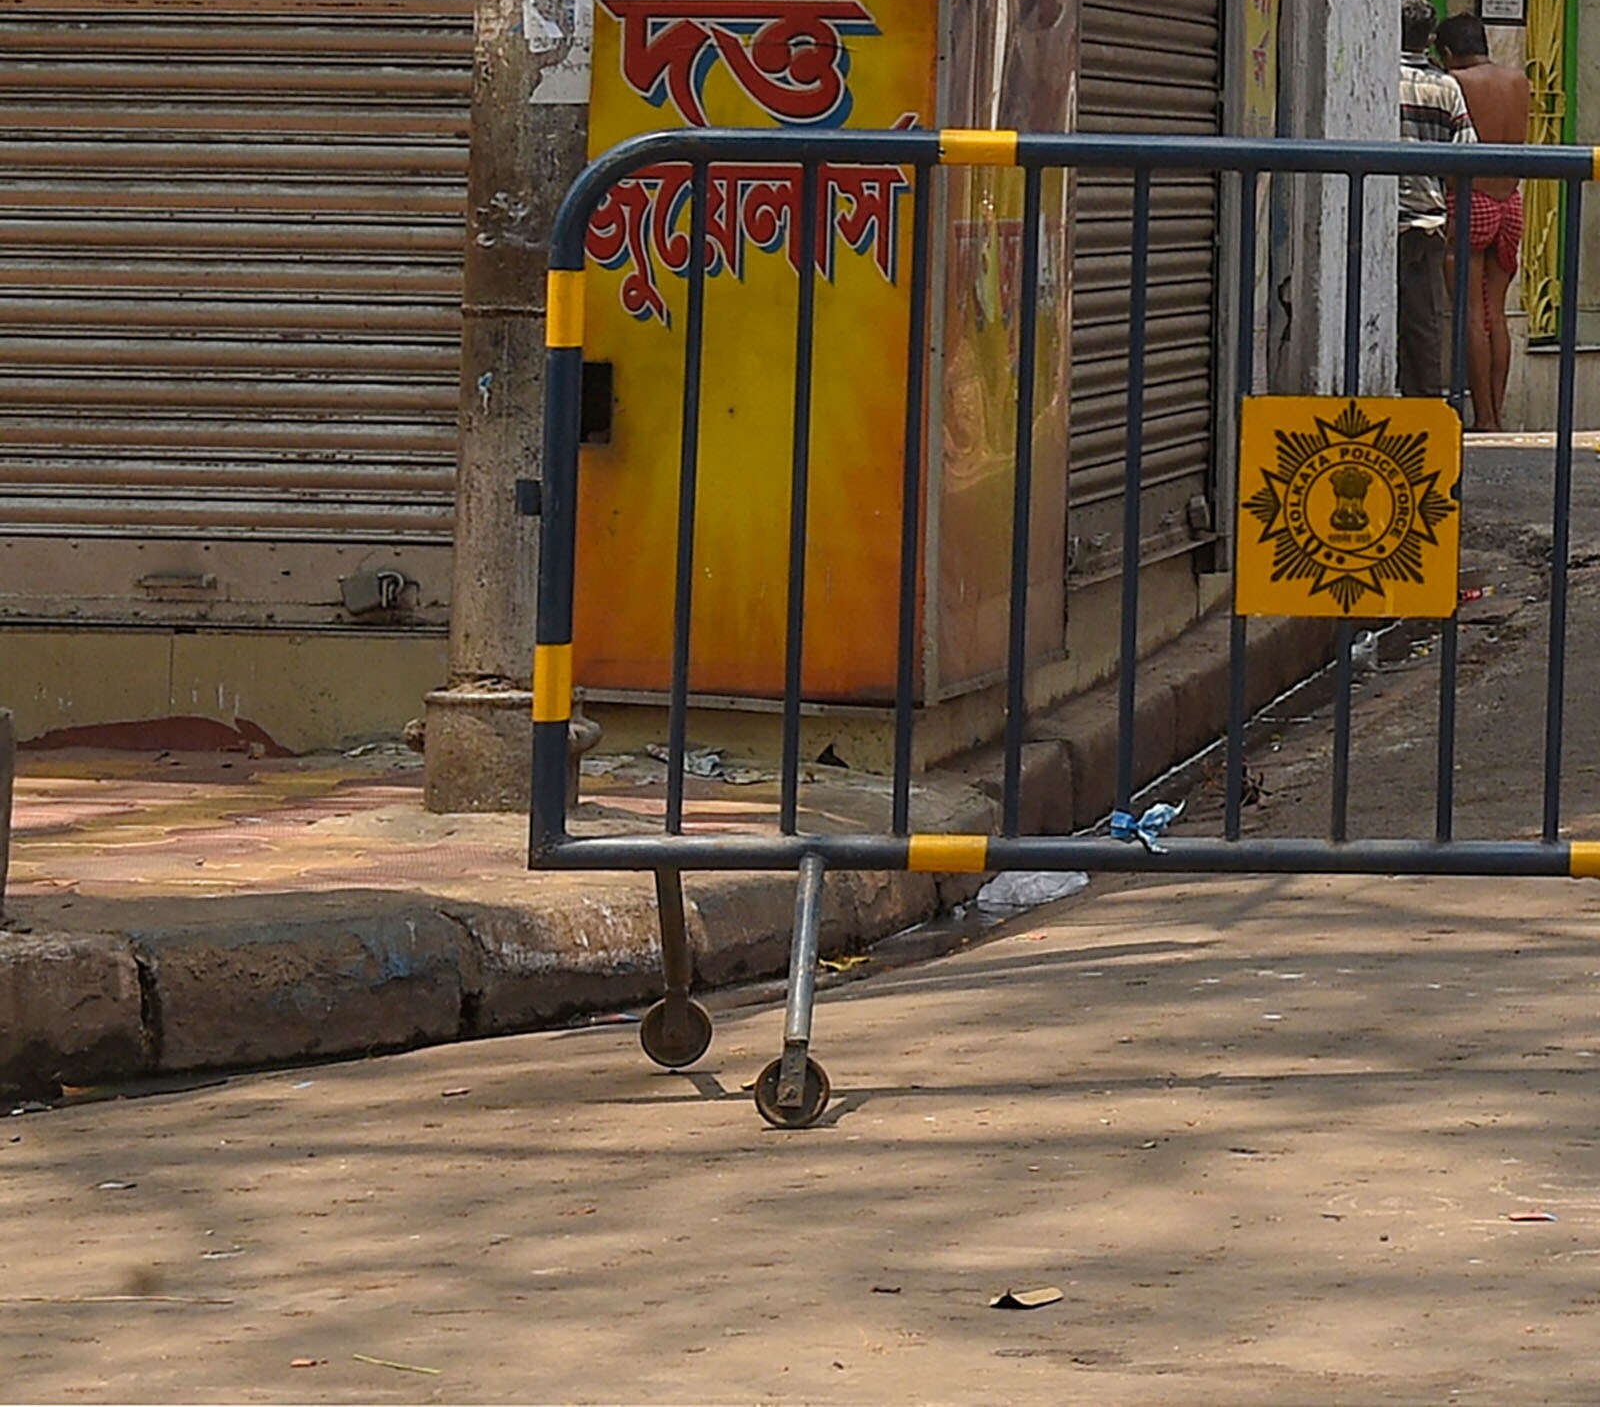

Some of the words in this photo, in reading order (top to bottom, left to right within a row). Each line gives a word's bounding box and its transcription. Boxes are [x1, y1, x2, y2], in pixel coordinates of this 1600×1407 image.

[1290, 454, 1330, 536] KOLKATA
[1340, 447, 1396, 482] POLICE
[1394, 482, 1410, 539] FORCE
